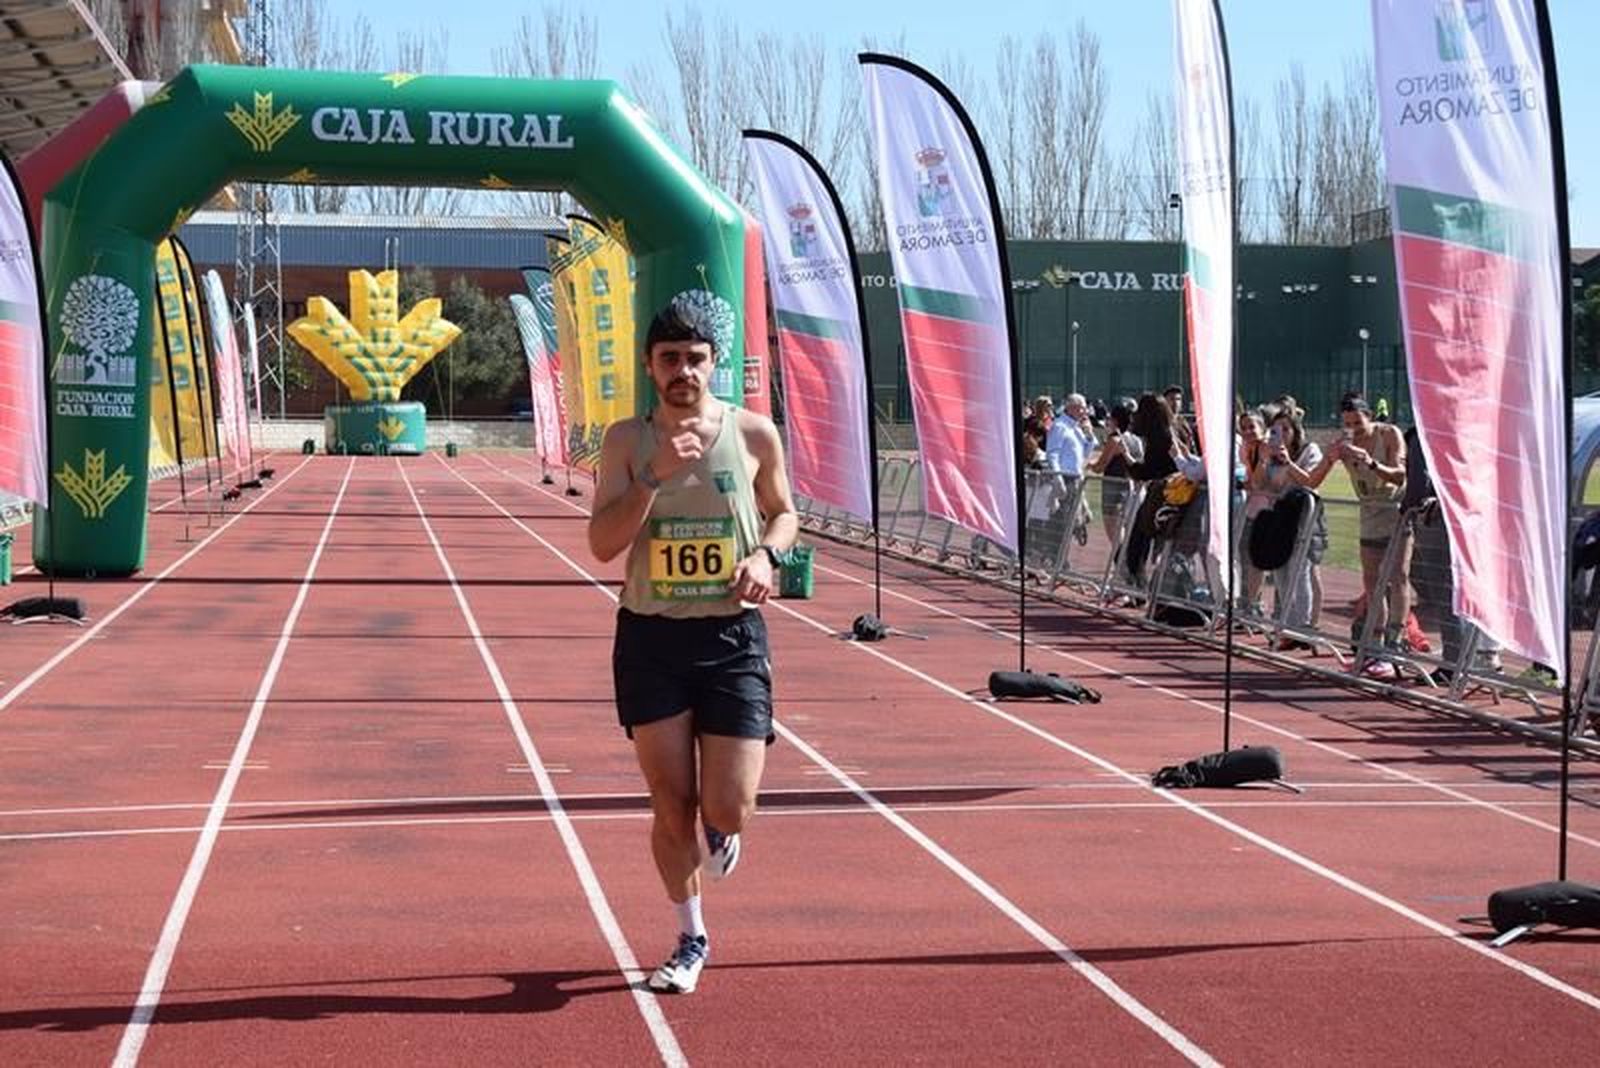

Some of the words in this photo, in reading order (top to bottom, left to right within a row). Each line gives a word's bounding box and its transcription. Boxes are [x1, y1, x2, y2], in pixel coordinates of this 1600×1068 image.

[311, 107, 415, 144] CAJA
[428, 111, 574, 148] RURAL
[1080, 271, 1142, 291] CAJA
[1151, 273, 1186, 290] RU
[57, 390, 135, 404] FUNDACION
[57, 403, 88, 417] CAJA
[91, 404, 136, 418] RURAL
[660, 544, 722, 576] 166
